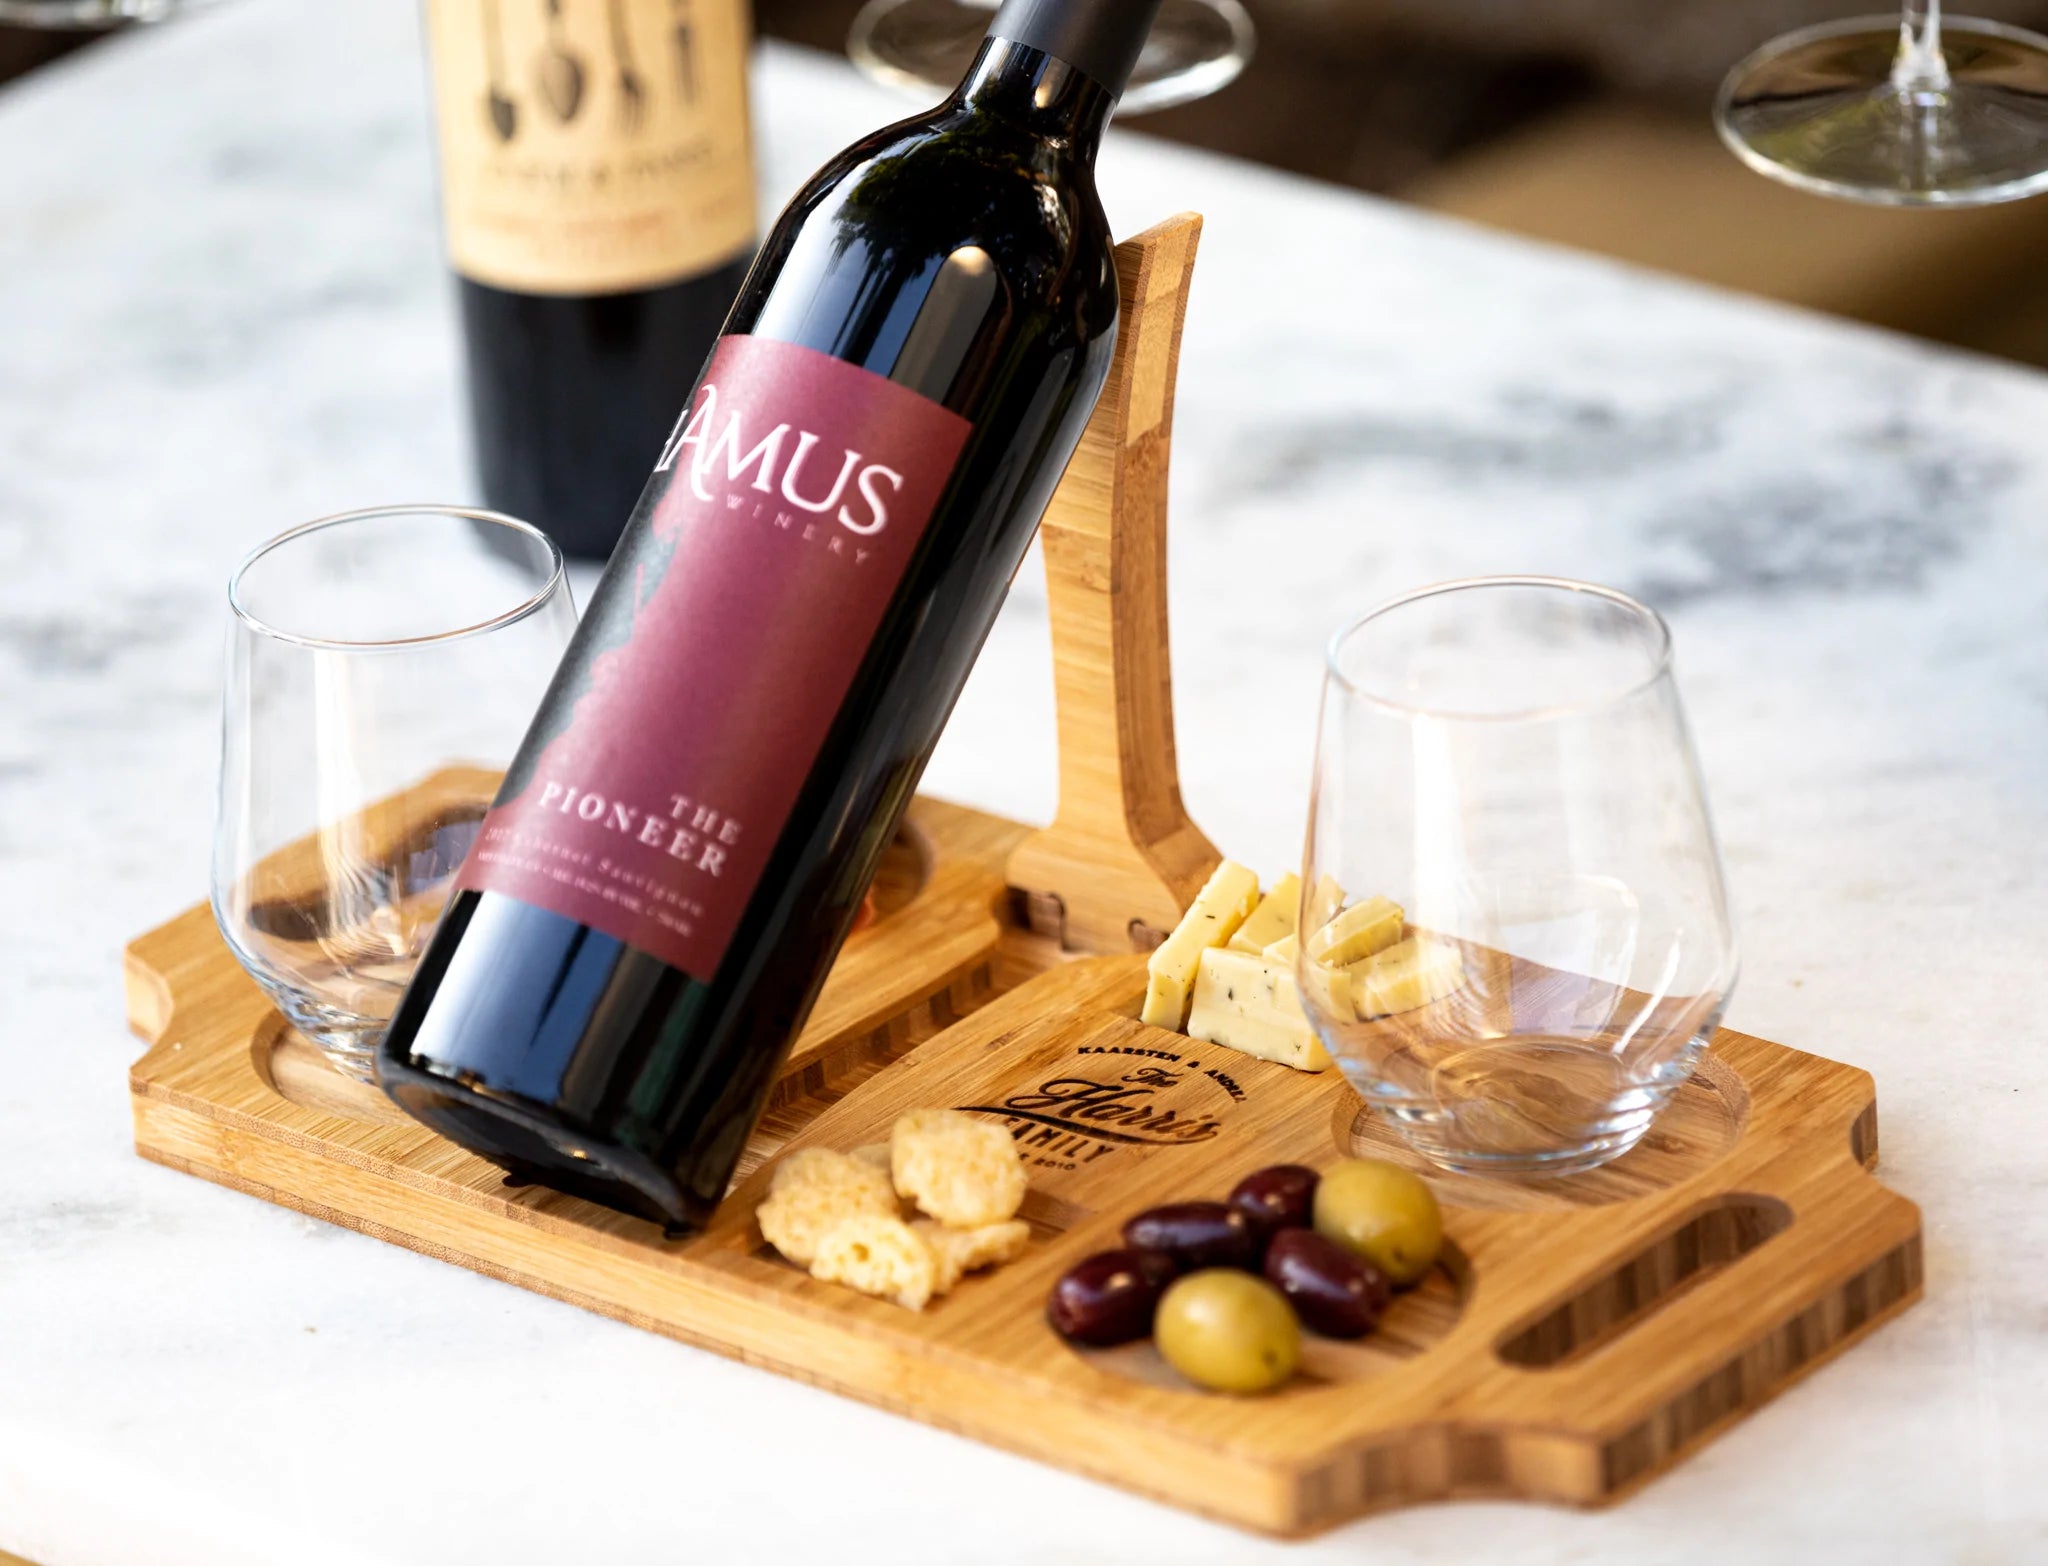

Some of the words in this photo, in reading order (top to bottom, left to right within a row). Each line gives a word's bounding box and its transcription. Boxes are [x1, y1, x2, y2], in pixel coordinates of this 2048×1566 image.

[726, 494, 870, 564] WINERY
[538, 781, 728, 878] PIONEER
[670, 794, 742, 845] THE
[598, 857, 704, 918] Sauvignon
[1077, 1046, 1182, 1062] KAARSTEN
[1121, 1067, 1185, 1088] The
